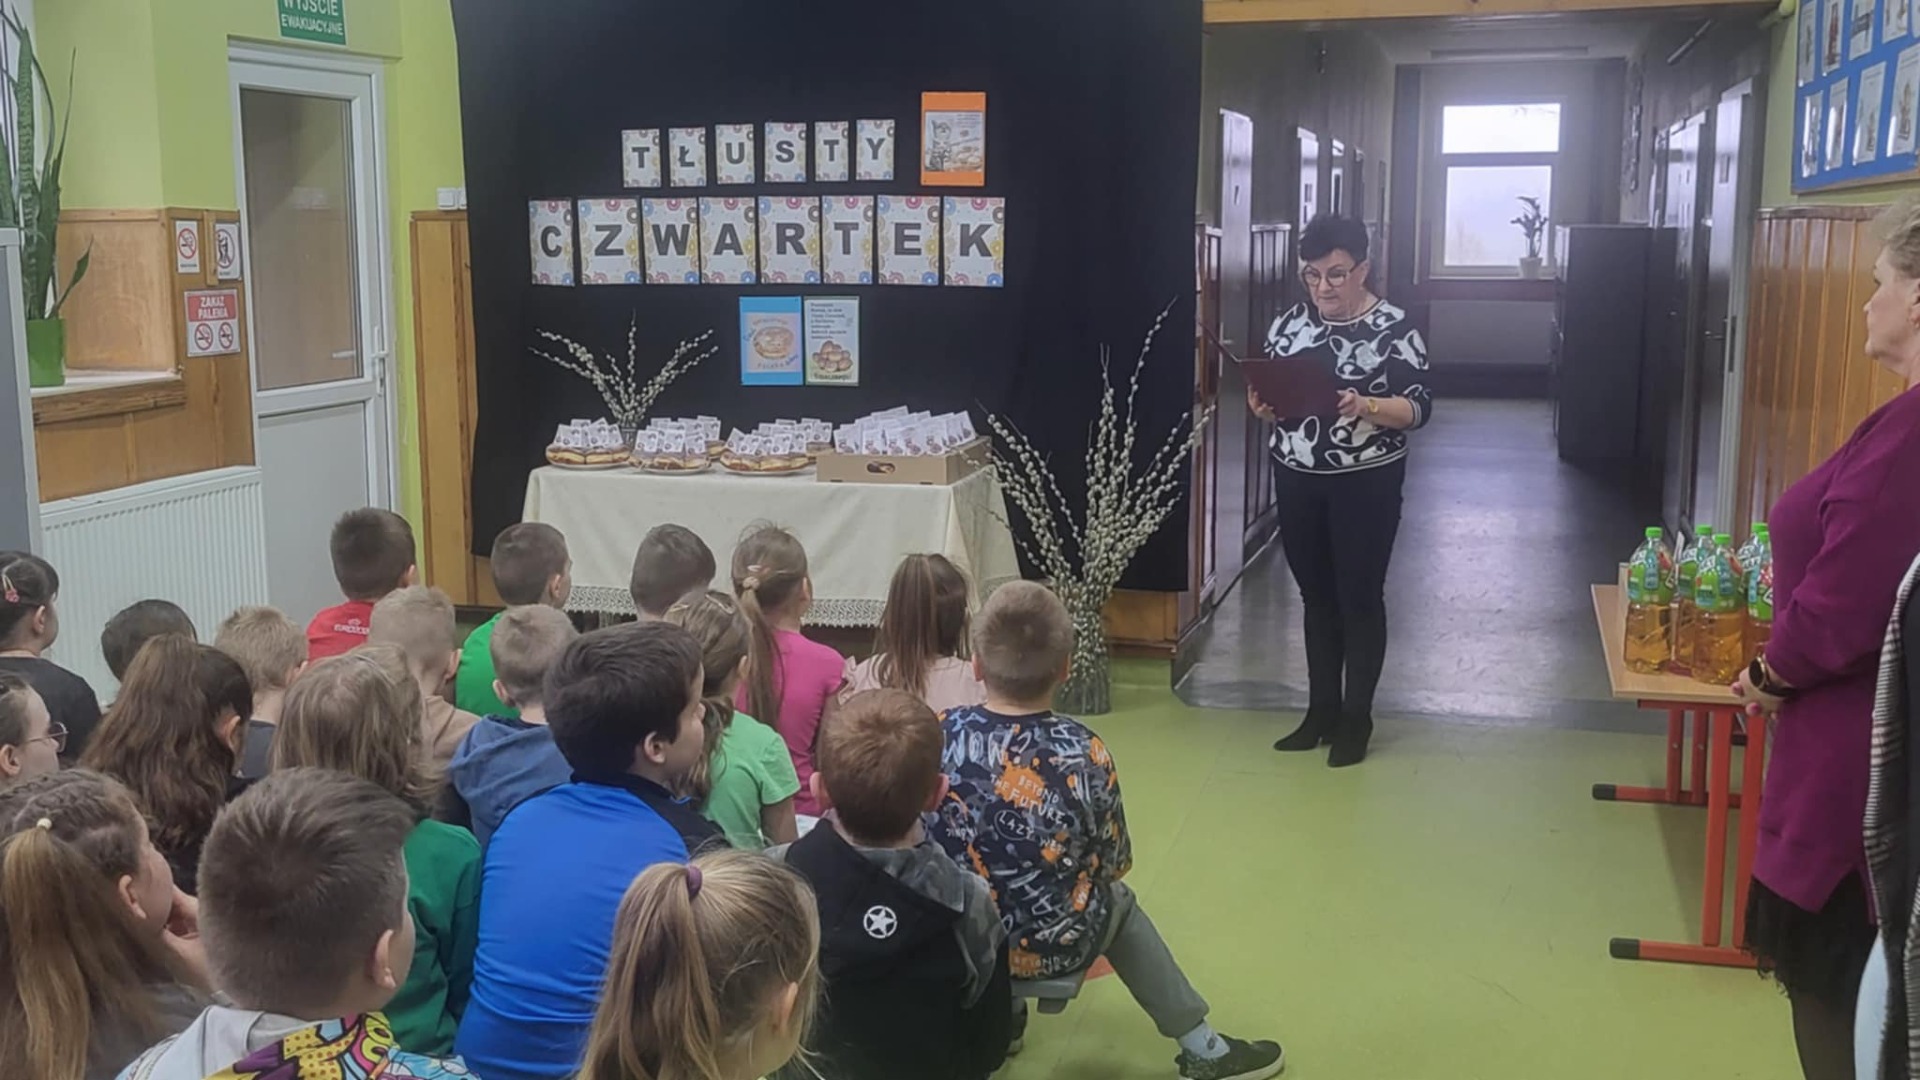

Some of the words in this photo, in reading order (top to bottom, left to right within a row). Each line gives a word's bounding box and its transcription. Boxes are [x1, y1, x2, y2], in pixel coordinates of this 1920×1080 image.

[281, 13, 344, 36] EWAKUACYJNE
[631, 138, 885, 169] TŁUSTY
[540, 222, 993, 258] CZWARTEK
[990, 773, 1010, 791] THE
[1018, 775, 1060, 804] BEYOND
[999, 811, 1035, 840] LAZY
